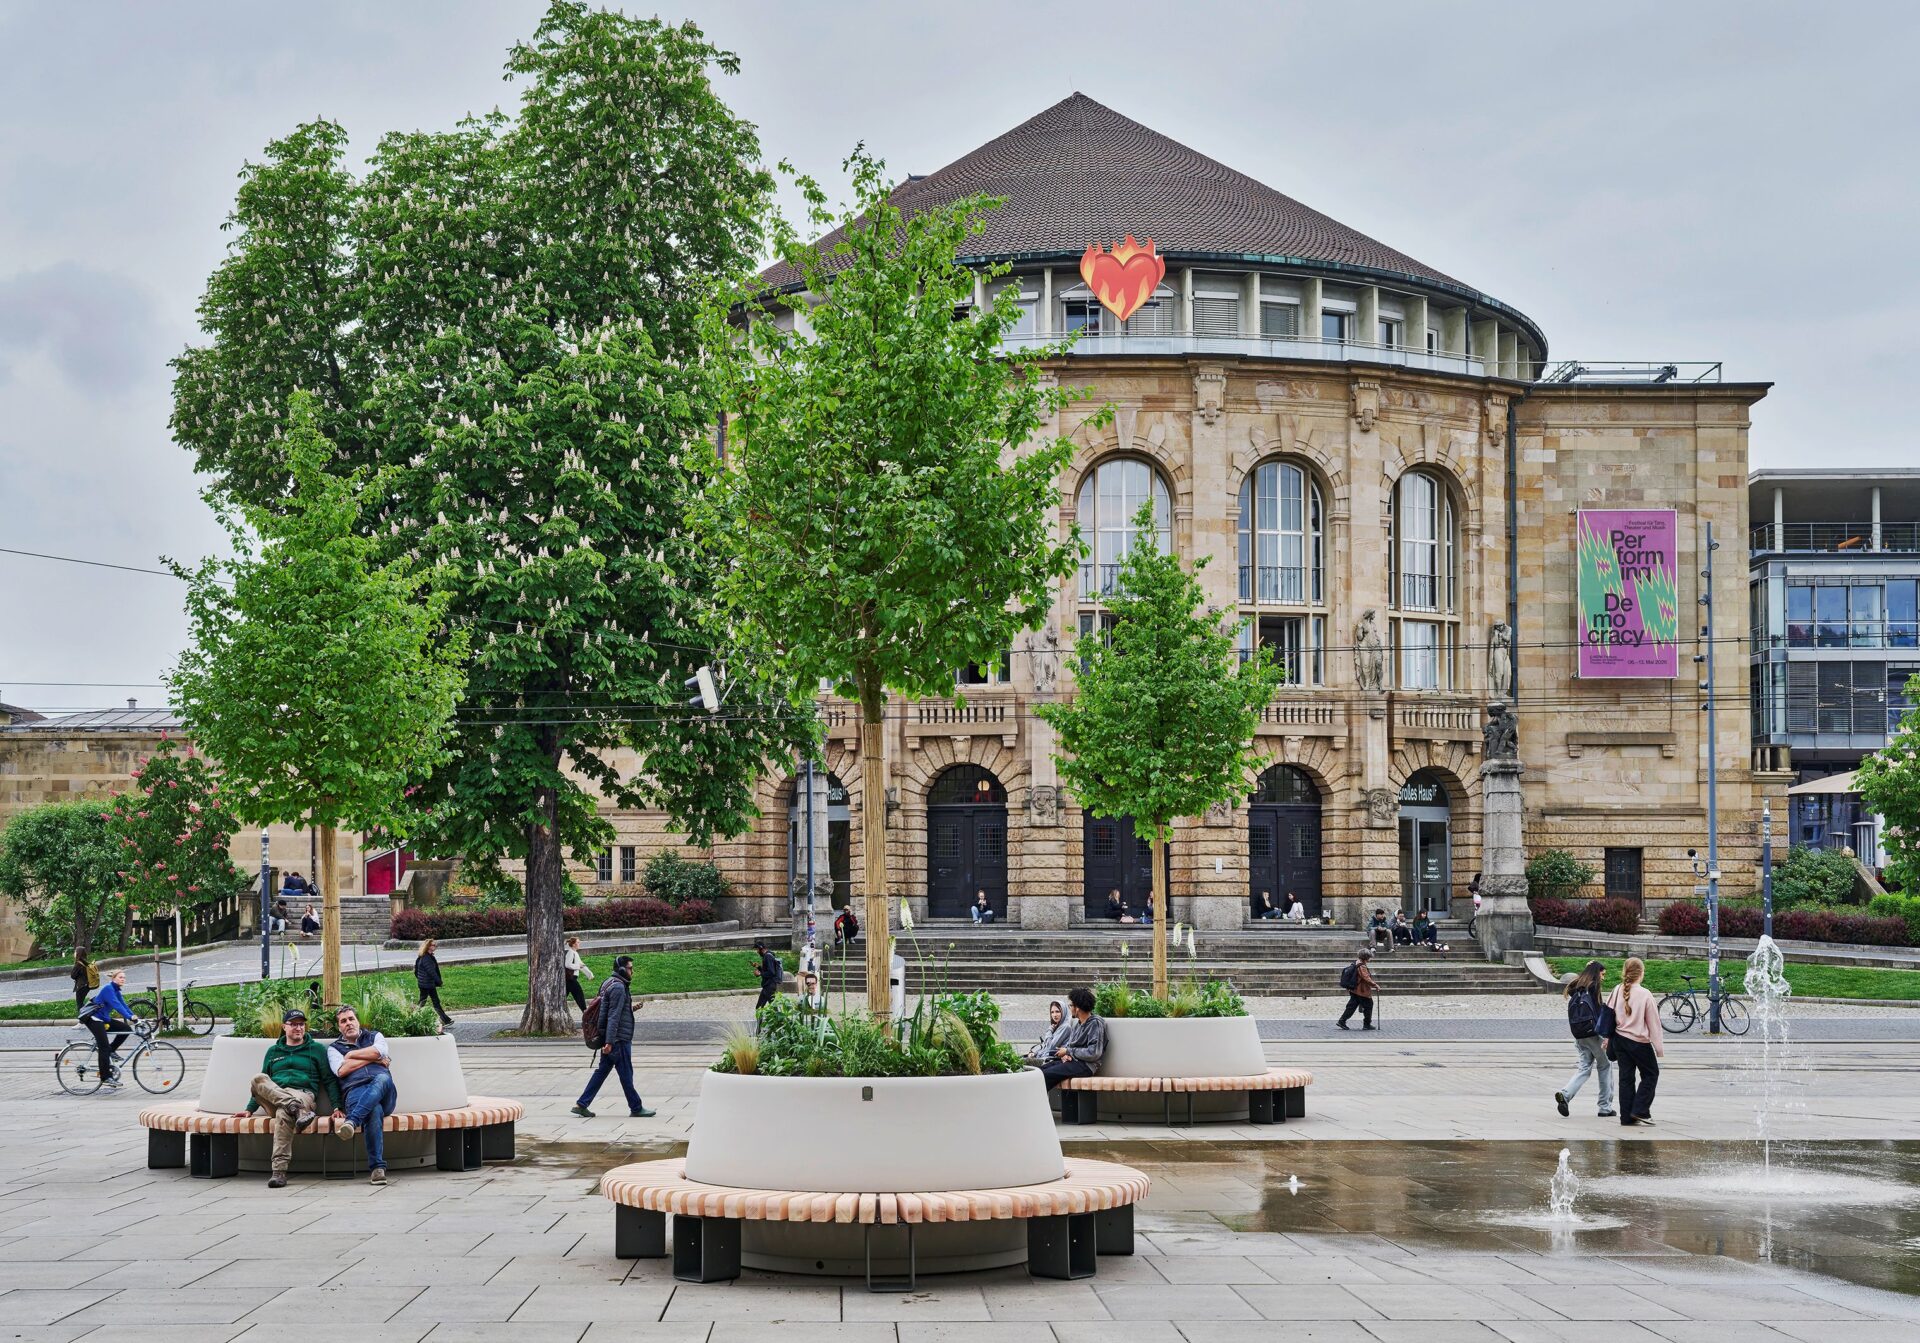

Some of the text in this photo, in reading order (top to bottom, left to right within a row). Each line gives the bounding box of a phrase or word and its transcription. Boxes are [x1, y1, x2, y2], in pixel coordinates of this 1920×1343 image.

[1611, 530, 1646, 548] Per
[1616, 546, 1664, 564] form
[1621, 563, 1651, 583] ing
[1604, 594, 1633, 612] De
[1593, 614, 1626, 627] mo
[1587, 629, 1645, 648] cracy
[1418, 784, 1432, 801] Haus
